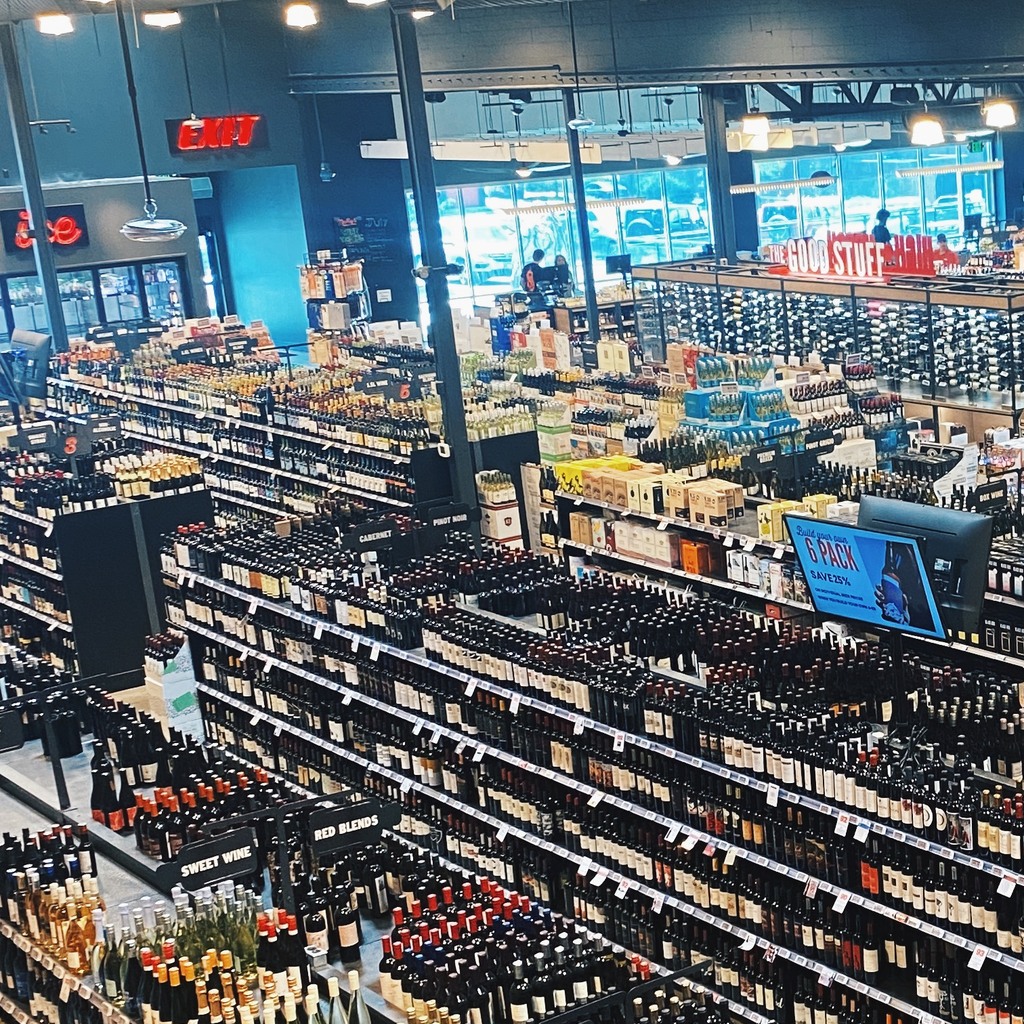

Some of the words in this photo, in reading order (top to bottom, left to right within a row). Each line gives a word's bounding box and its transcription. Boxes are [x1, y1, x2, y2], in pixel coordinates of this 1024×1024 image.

[178, 115, 260, 150] EXIT
[768, 244, 785, 264] THE
[787, 239, 830, 275] GOOD
[833, 241, 885, 277] STUFF
[991, 490, 1004, 499] WINE
[433, 516, 452, 526] PINOT
[452, 514, 468, 522] NOIR
[359, 530, 393, 543] CABERNET
[804, 537, 819, 564] 6
[817, 540, 860, 572] PACK
[314, 826, 336, 842] RED
[338, 815, 379, 834] BLENDS
[181, 854, 220, 877] SWEET
[222, 846, 252, 864] WINE
